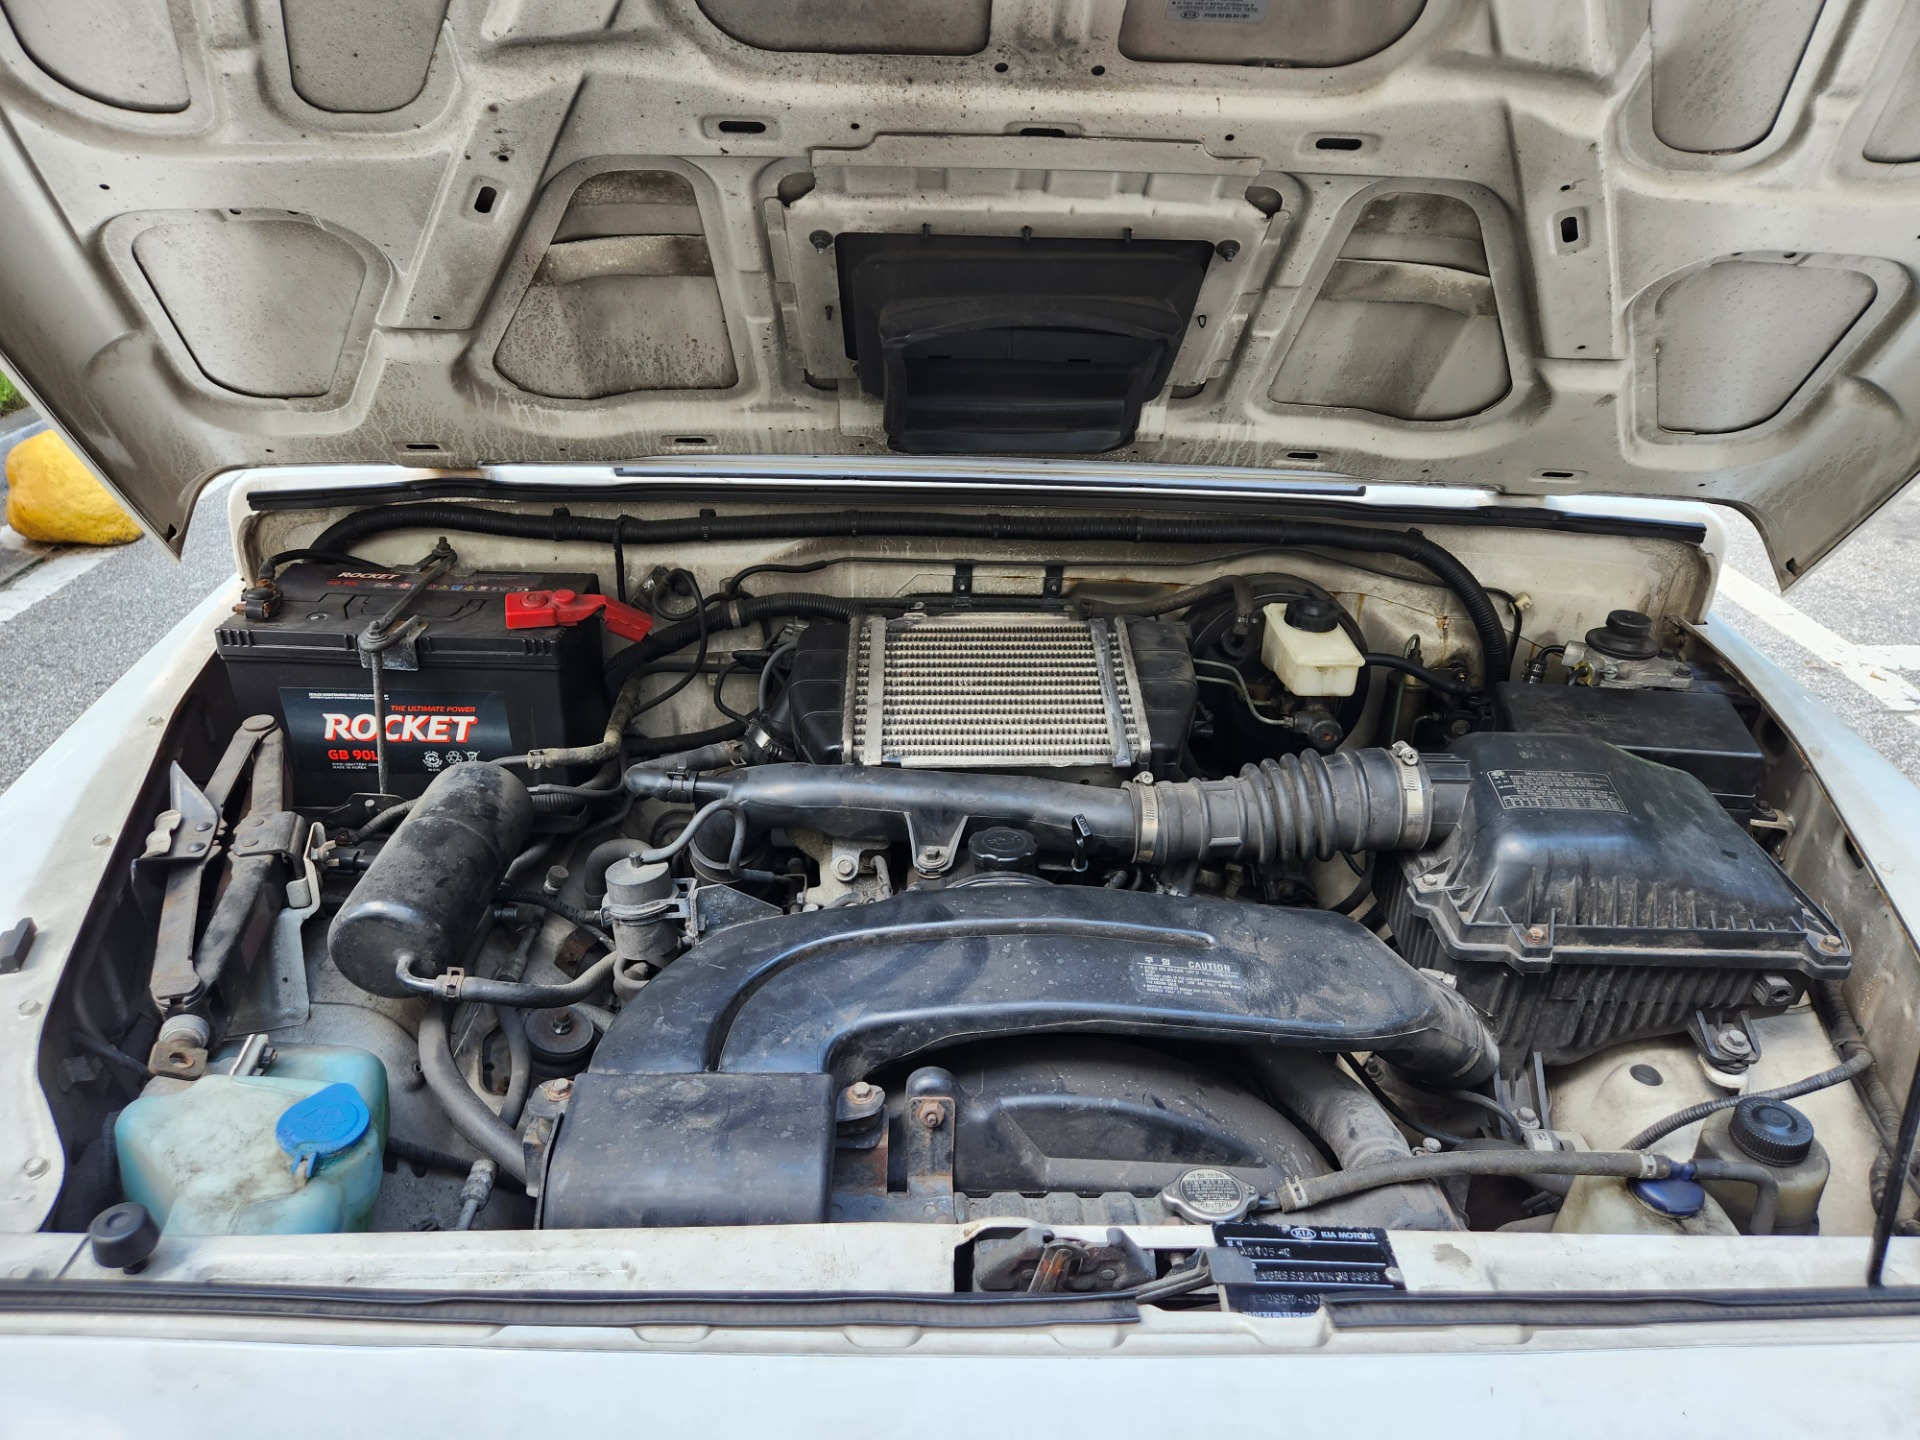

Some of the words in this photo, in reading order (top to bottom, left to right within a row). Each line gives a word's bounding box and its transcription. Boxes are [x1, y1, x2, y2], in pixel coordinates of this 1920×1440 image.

[337, 571, 401, 580] ROCKET
[322, 713, 478, 743] ROCKET
[328, 749, 350, 760] GB
[352, 749, 379, 761] 90L
[1188, 961, 1231, 972] CAUTION
[1294, 1229, 1313, 1238] KIA
[1321, 1231, 1337, 1239] KIA
[1338, 1232, 1376, 1240] MOTORS
